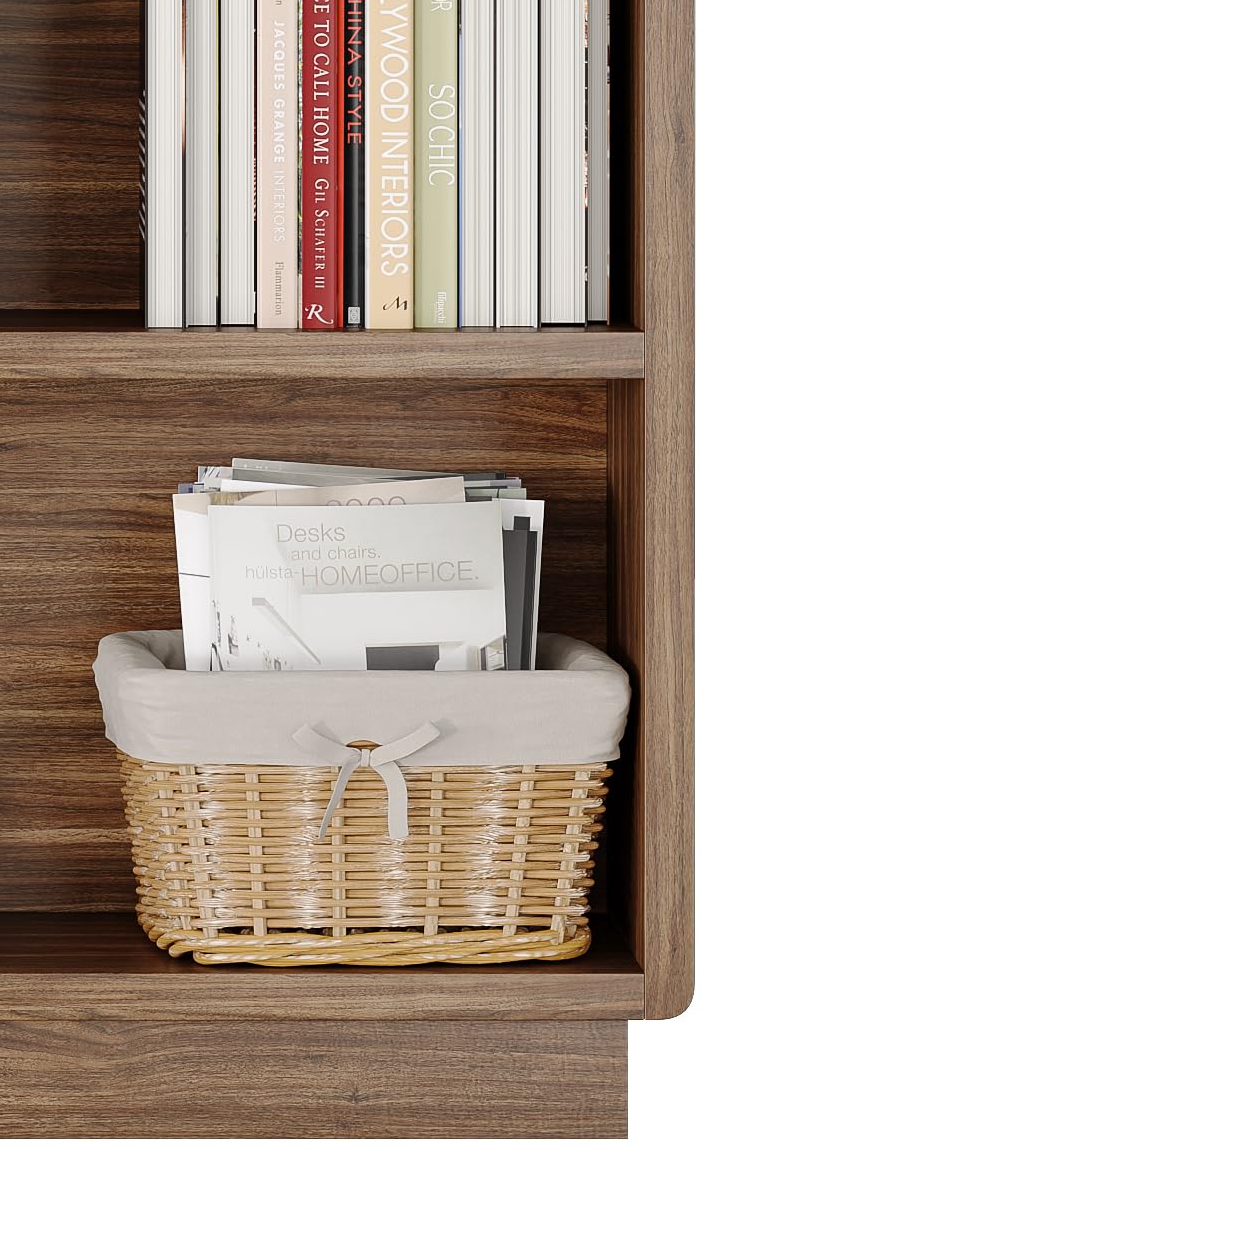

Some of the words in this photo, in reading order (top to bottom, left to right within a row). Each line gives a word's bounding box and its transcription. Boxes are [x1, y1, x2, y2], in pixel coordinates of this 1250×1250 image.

[273, 20, 286, 90] JACQUES
[313, 20, 330, 48] TO
[313, 53, 330, 101] CALL
[428, 84, 455, 120] SO
[273, 100, 286, 163] GRANGE
[313, 107, 330, 165] HOME
[347, 75, 362, 144] STYLE
[428, 125, 455, 186] CHIC
[273, 170, 286, 243] INTERIORS
[381, 132, 409, 276] INTERIORS
[275, 261, 285, 316] Flammarion
[314, 276, 326, 289] III
[276, 523, 346, 543] Desks
[291, 546, 322, 561] and
[327, 545, 381, 560] chairs.
